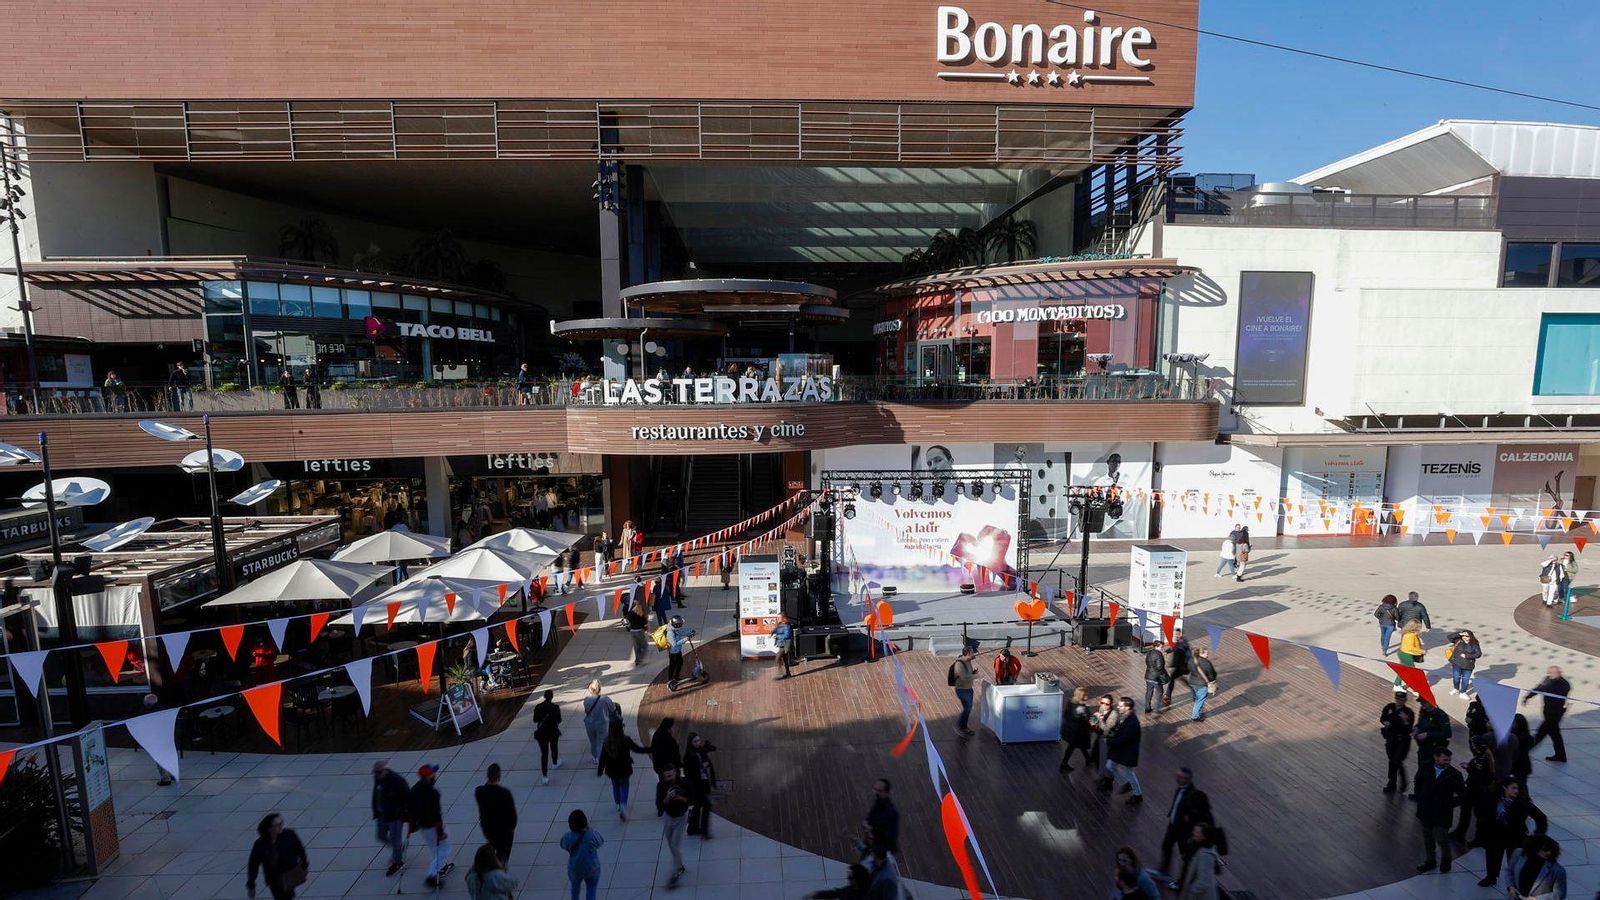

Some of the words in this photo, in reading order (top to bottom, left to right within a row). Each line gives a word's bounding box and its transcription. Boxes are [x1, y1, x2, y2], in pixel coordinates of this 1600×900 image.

[937, 6, 1152, 67] Bonaire
[396, 322, 455, 338] TACO
[457, 327, 496, 342] BELL
[603, 378, 663, 403] LAS
[672, 376, 833, 402] TERRAZAS
[631, 423, 748, 439] restaurantes
[753, 425, 765, 442] y
[770, 420, 805, 437] cine
[303, 459, 371, 472] lefties
[487, 452, 555, 469] lefties
[1500, 452, 1574, 462] CALZEDONIA
[894, 508, 952, 519] Volvemos
[0, 516, 71, 539] TARBUKS
[905, 525, 913, 533] a
[915, 521, 940, 533] latir
[242, 547, 298, 576] STARBUCKS
